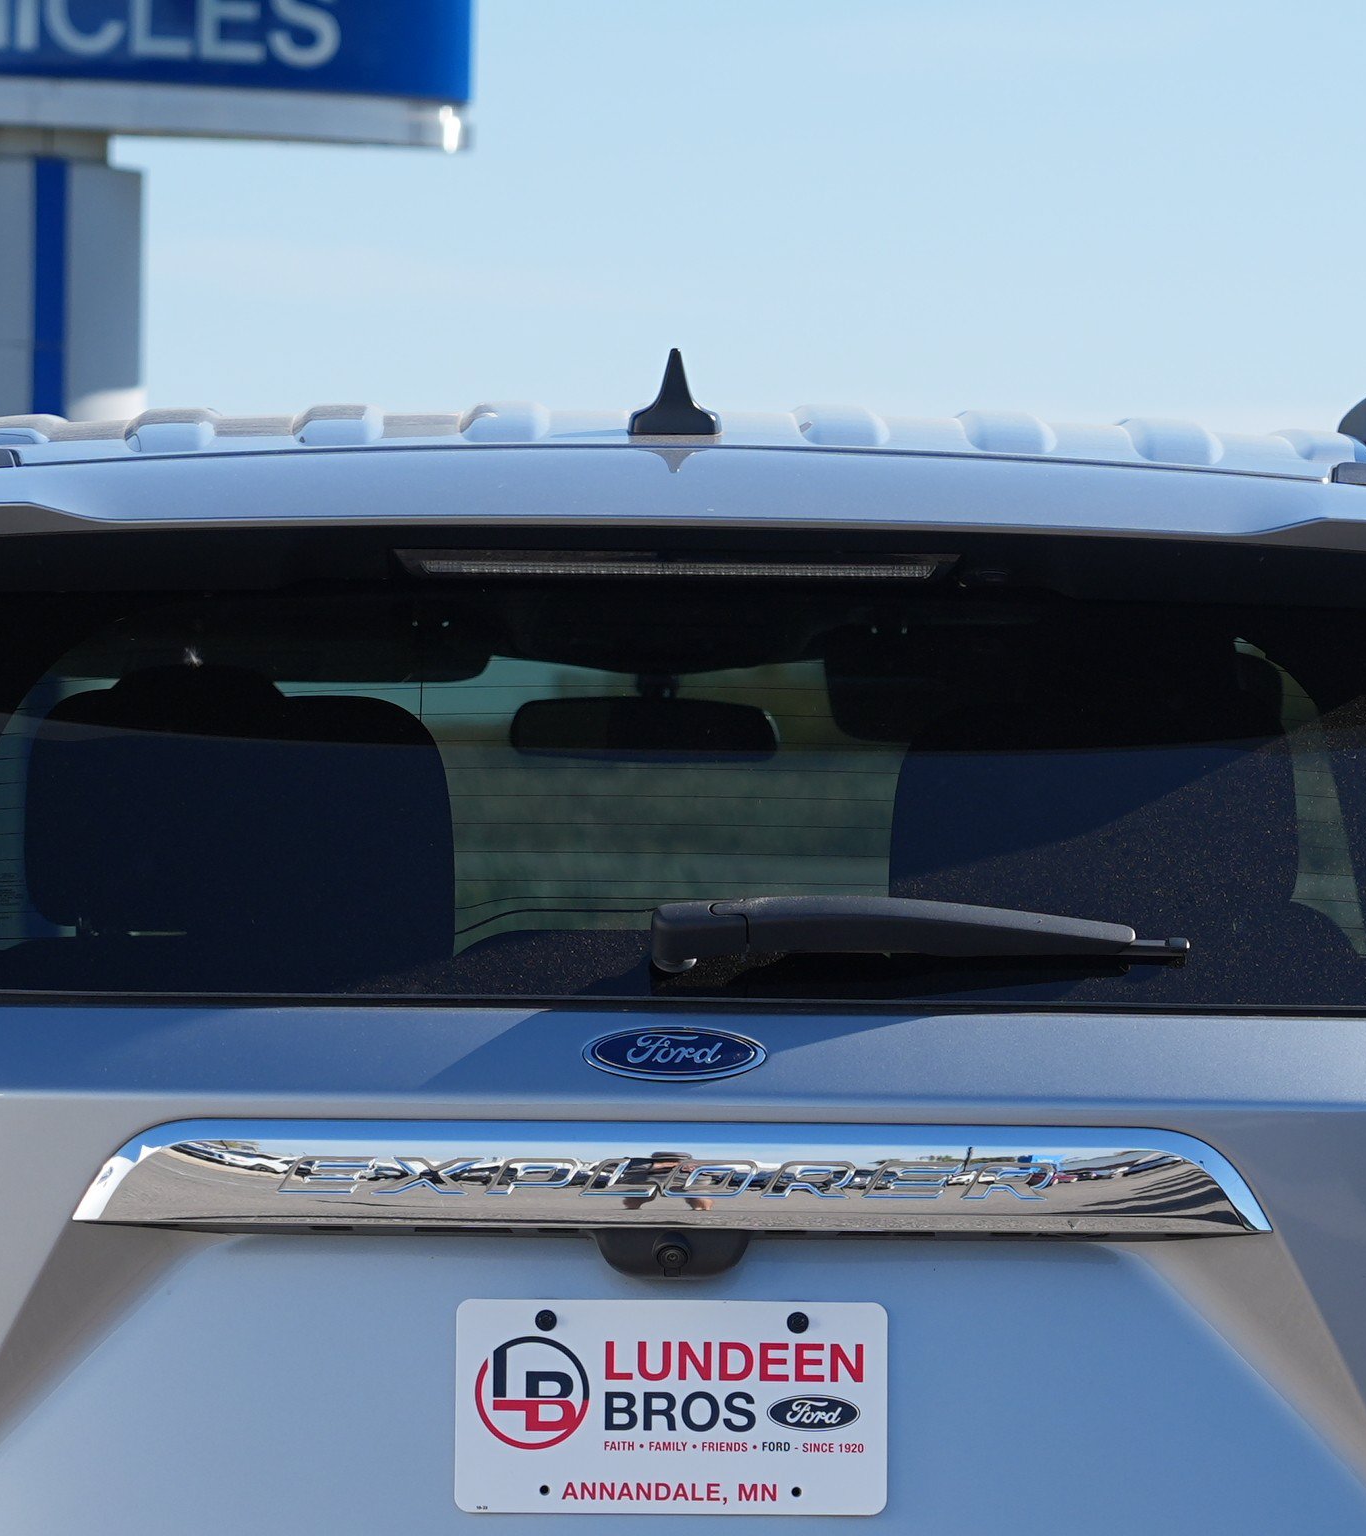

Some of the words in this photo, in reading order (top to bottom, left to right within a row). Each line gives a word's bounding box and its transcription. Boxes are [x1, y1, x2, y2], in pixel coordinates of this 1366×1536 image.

[627, 1034, 723, 1064] Ford
[276, 1155, 1056, 1200] EXPLORER
[605, 1341, 864, 1382] LUNDEEN
[604, 1391, 756, 1432] BROS
[786, 1399, 842, 1425] Ford
[604, 1441, 635, 1452] FAITH
[649, 1441, 687, 1452] FAMILY
[701, 1442, 748, 1452] FRIENDS
[762, 1441, 790, 1452] FORD
[802, 1443, 834, 1453] SINCE
[839, 1443, 864, 1453] 1920
[562, 1482, 728, 1505] ANNANDALE,
[738, 1483, 777, 1501] MN
